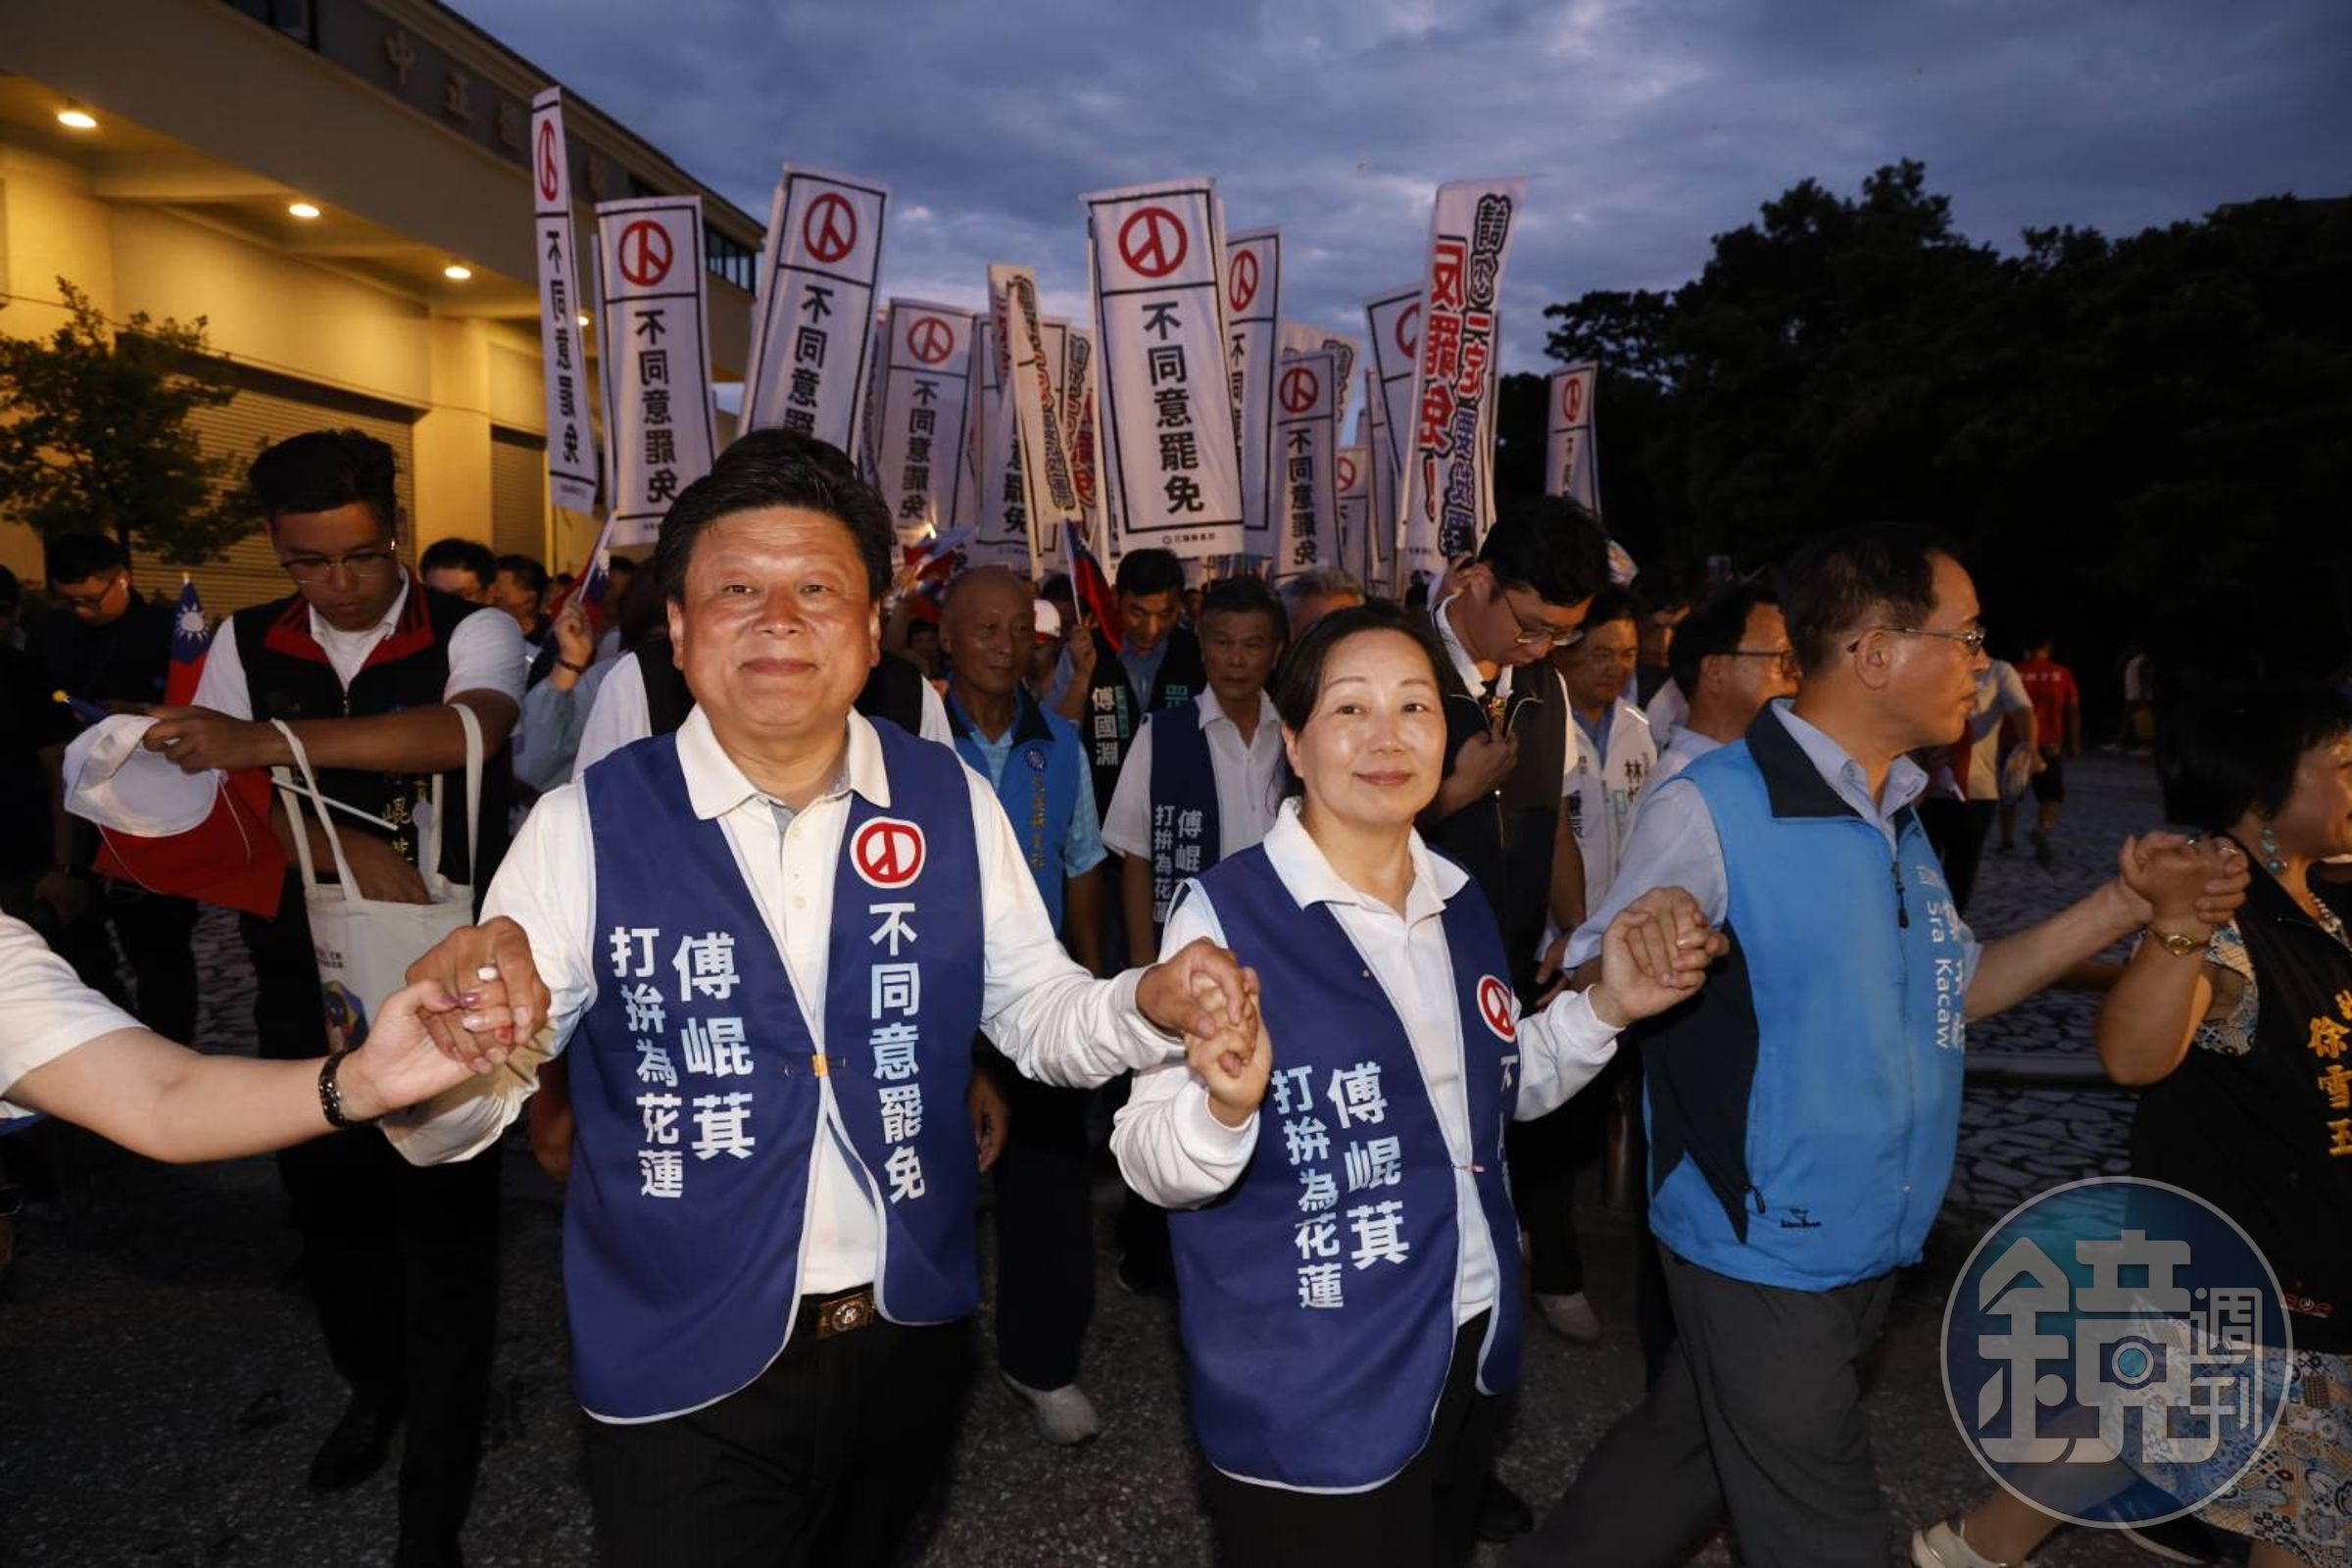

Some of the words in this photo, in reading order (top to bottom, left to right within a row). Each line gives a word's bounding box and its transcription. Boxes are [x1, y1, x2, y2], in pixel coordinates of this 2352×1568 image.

[1142, 301, 1204, 514] 不同意罷免
[1175, 808, 1203, 883] 傅崐
[1926, 900, 1944, 944] Sra
[610, 926, 684, 1199] 打拚為花蓮
[868, 901, 925, 1204] 不同意罷免
[1934, 957, 1952, 1050] Kacaw
[1271, 1064, 1345, 1309] 打拚為花蓮
